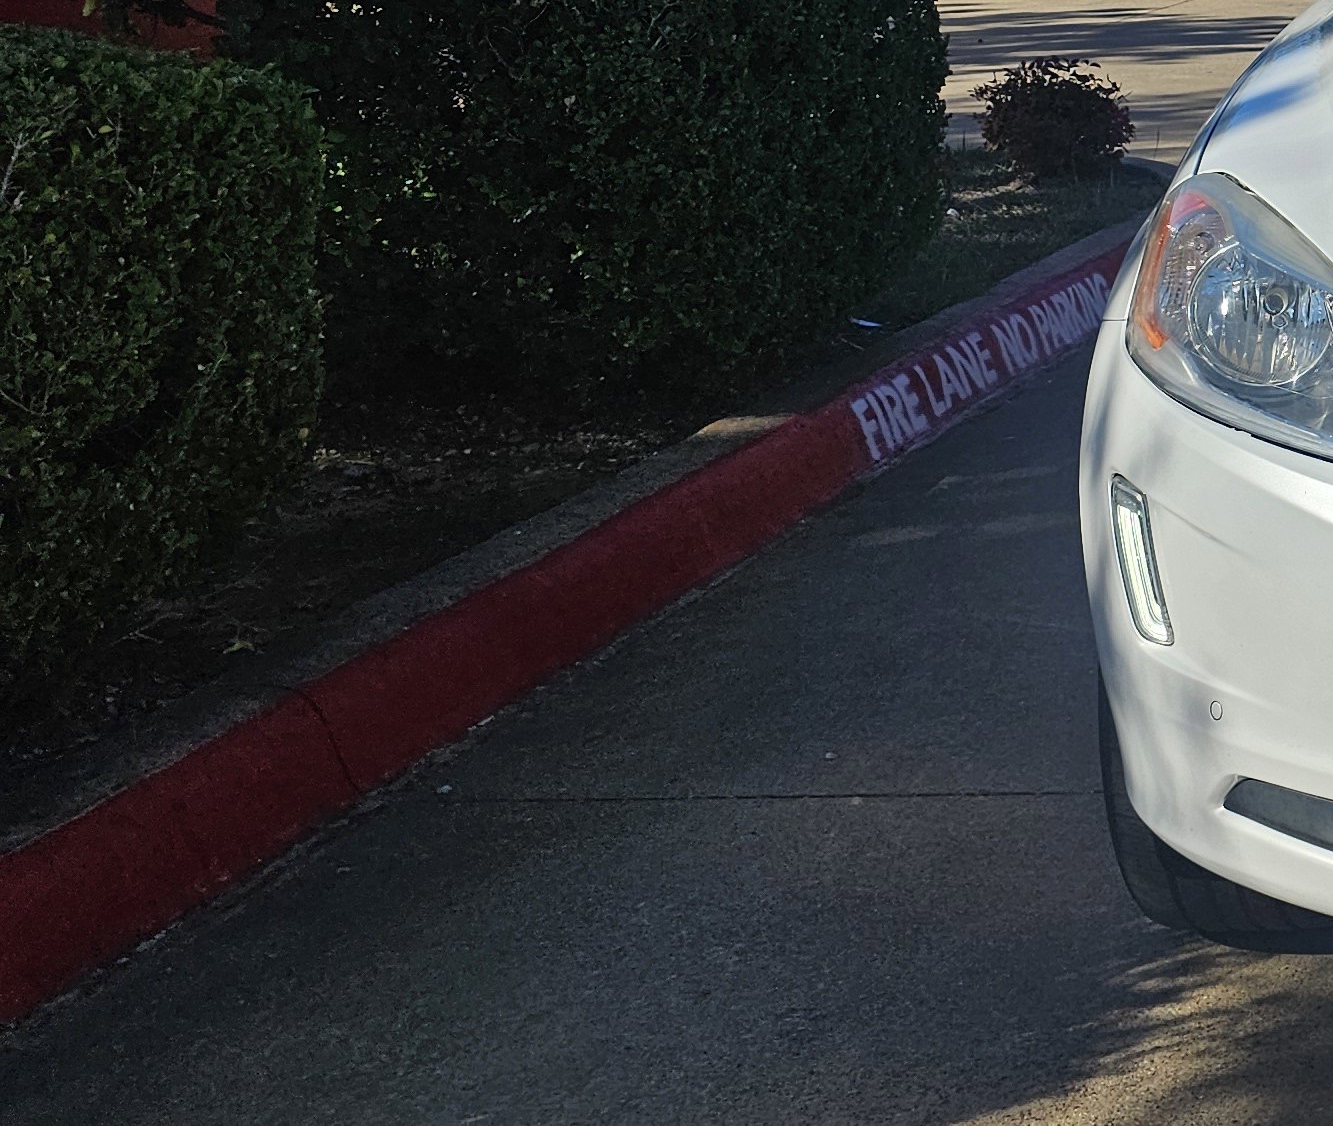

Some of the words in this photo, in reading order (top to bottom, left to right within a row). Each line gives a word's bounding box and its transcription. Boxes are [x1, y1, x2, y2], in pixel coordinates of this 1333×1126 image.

[851, 373, 928, 461] FIRE
[914, 332, 999, 417] LANE
[990, 313, 1040, 374] NO
